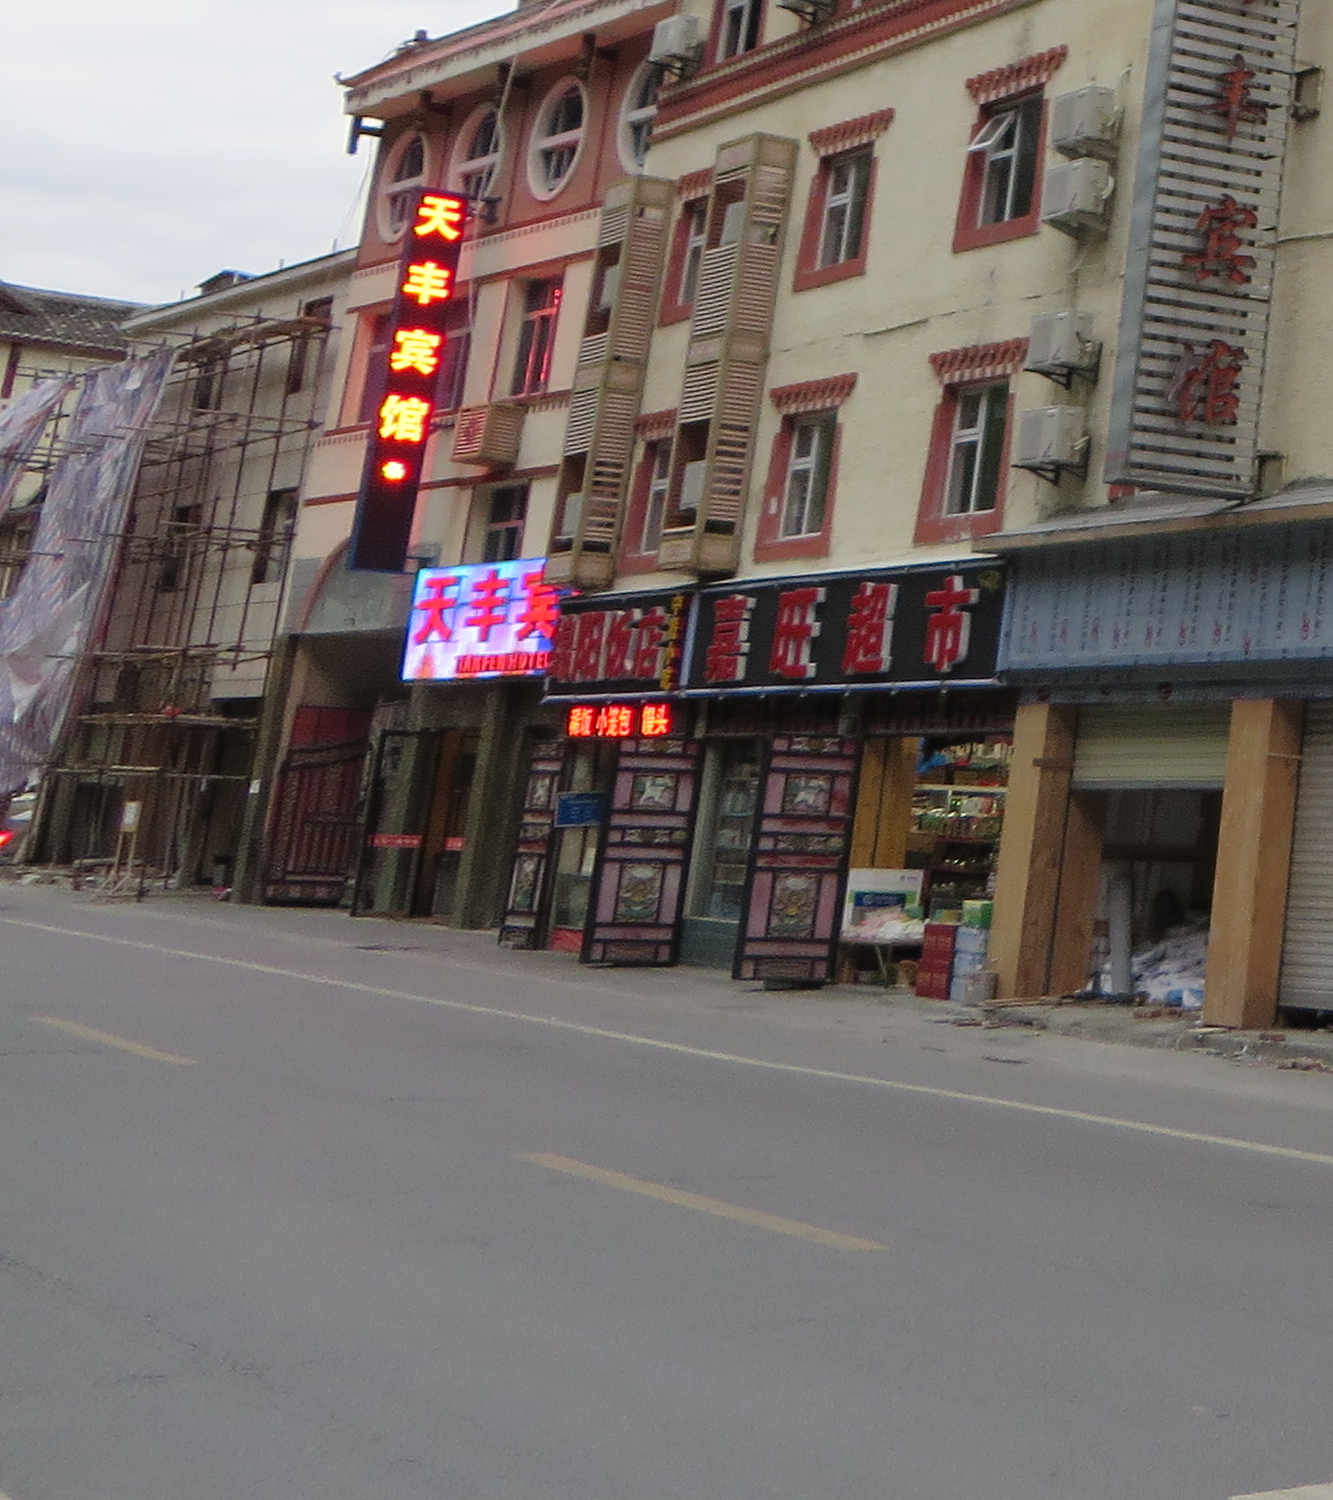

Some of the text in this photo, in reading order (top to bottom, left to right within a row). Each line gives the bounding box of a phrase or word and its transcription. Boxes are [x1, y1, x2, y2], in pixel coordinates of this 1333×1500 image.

[374, 193, 463, 444] 天丰宾馆
[413, 568, 568, 642] 天丰宾
[703, 574, 980, 683] 嘉旺超市
